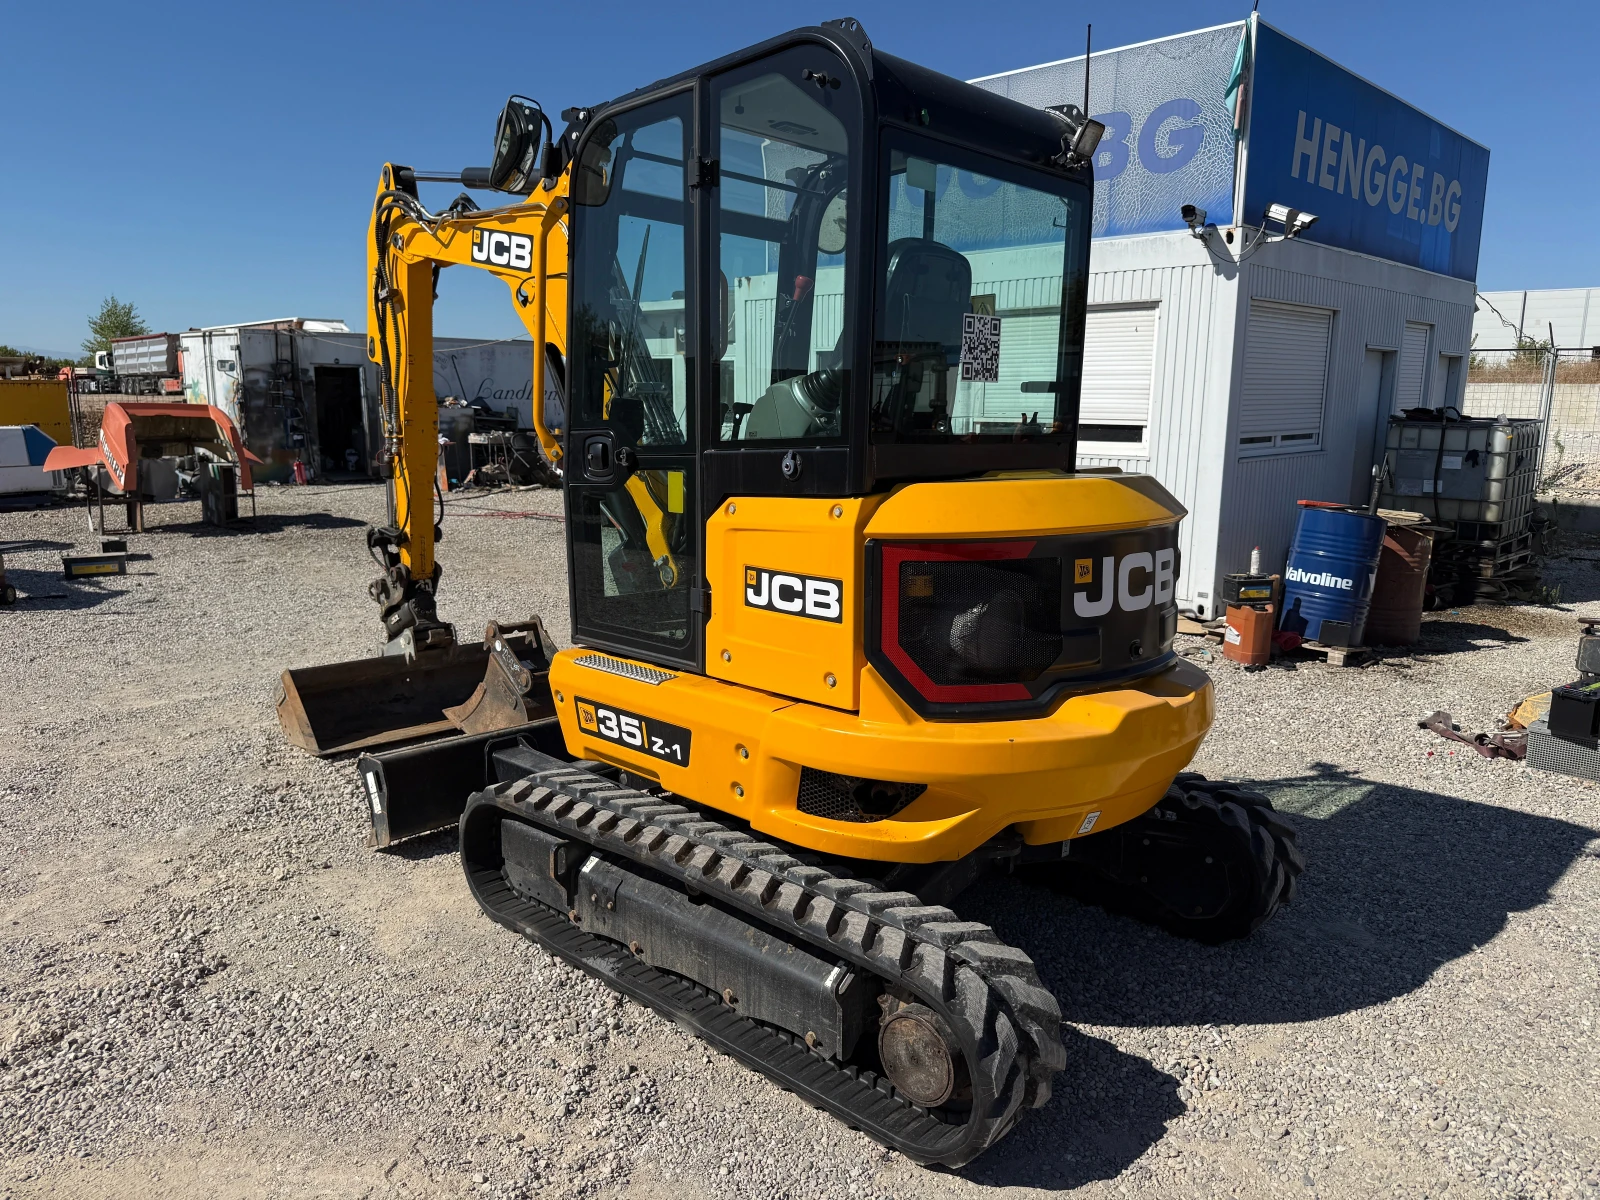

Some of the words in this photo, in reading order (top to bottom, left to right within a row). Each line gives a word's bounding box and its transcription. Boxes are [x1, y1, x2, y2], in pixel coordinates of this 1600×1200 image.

[1290, 109, 1462, 233] HENGGE.BG
[472, 230, 532, 269] JCB
[746, 571, 841, 619] JCB
[1073, 547, 1175, 618] JCB
[1285, 565, 1353, 590] Valvoline
